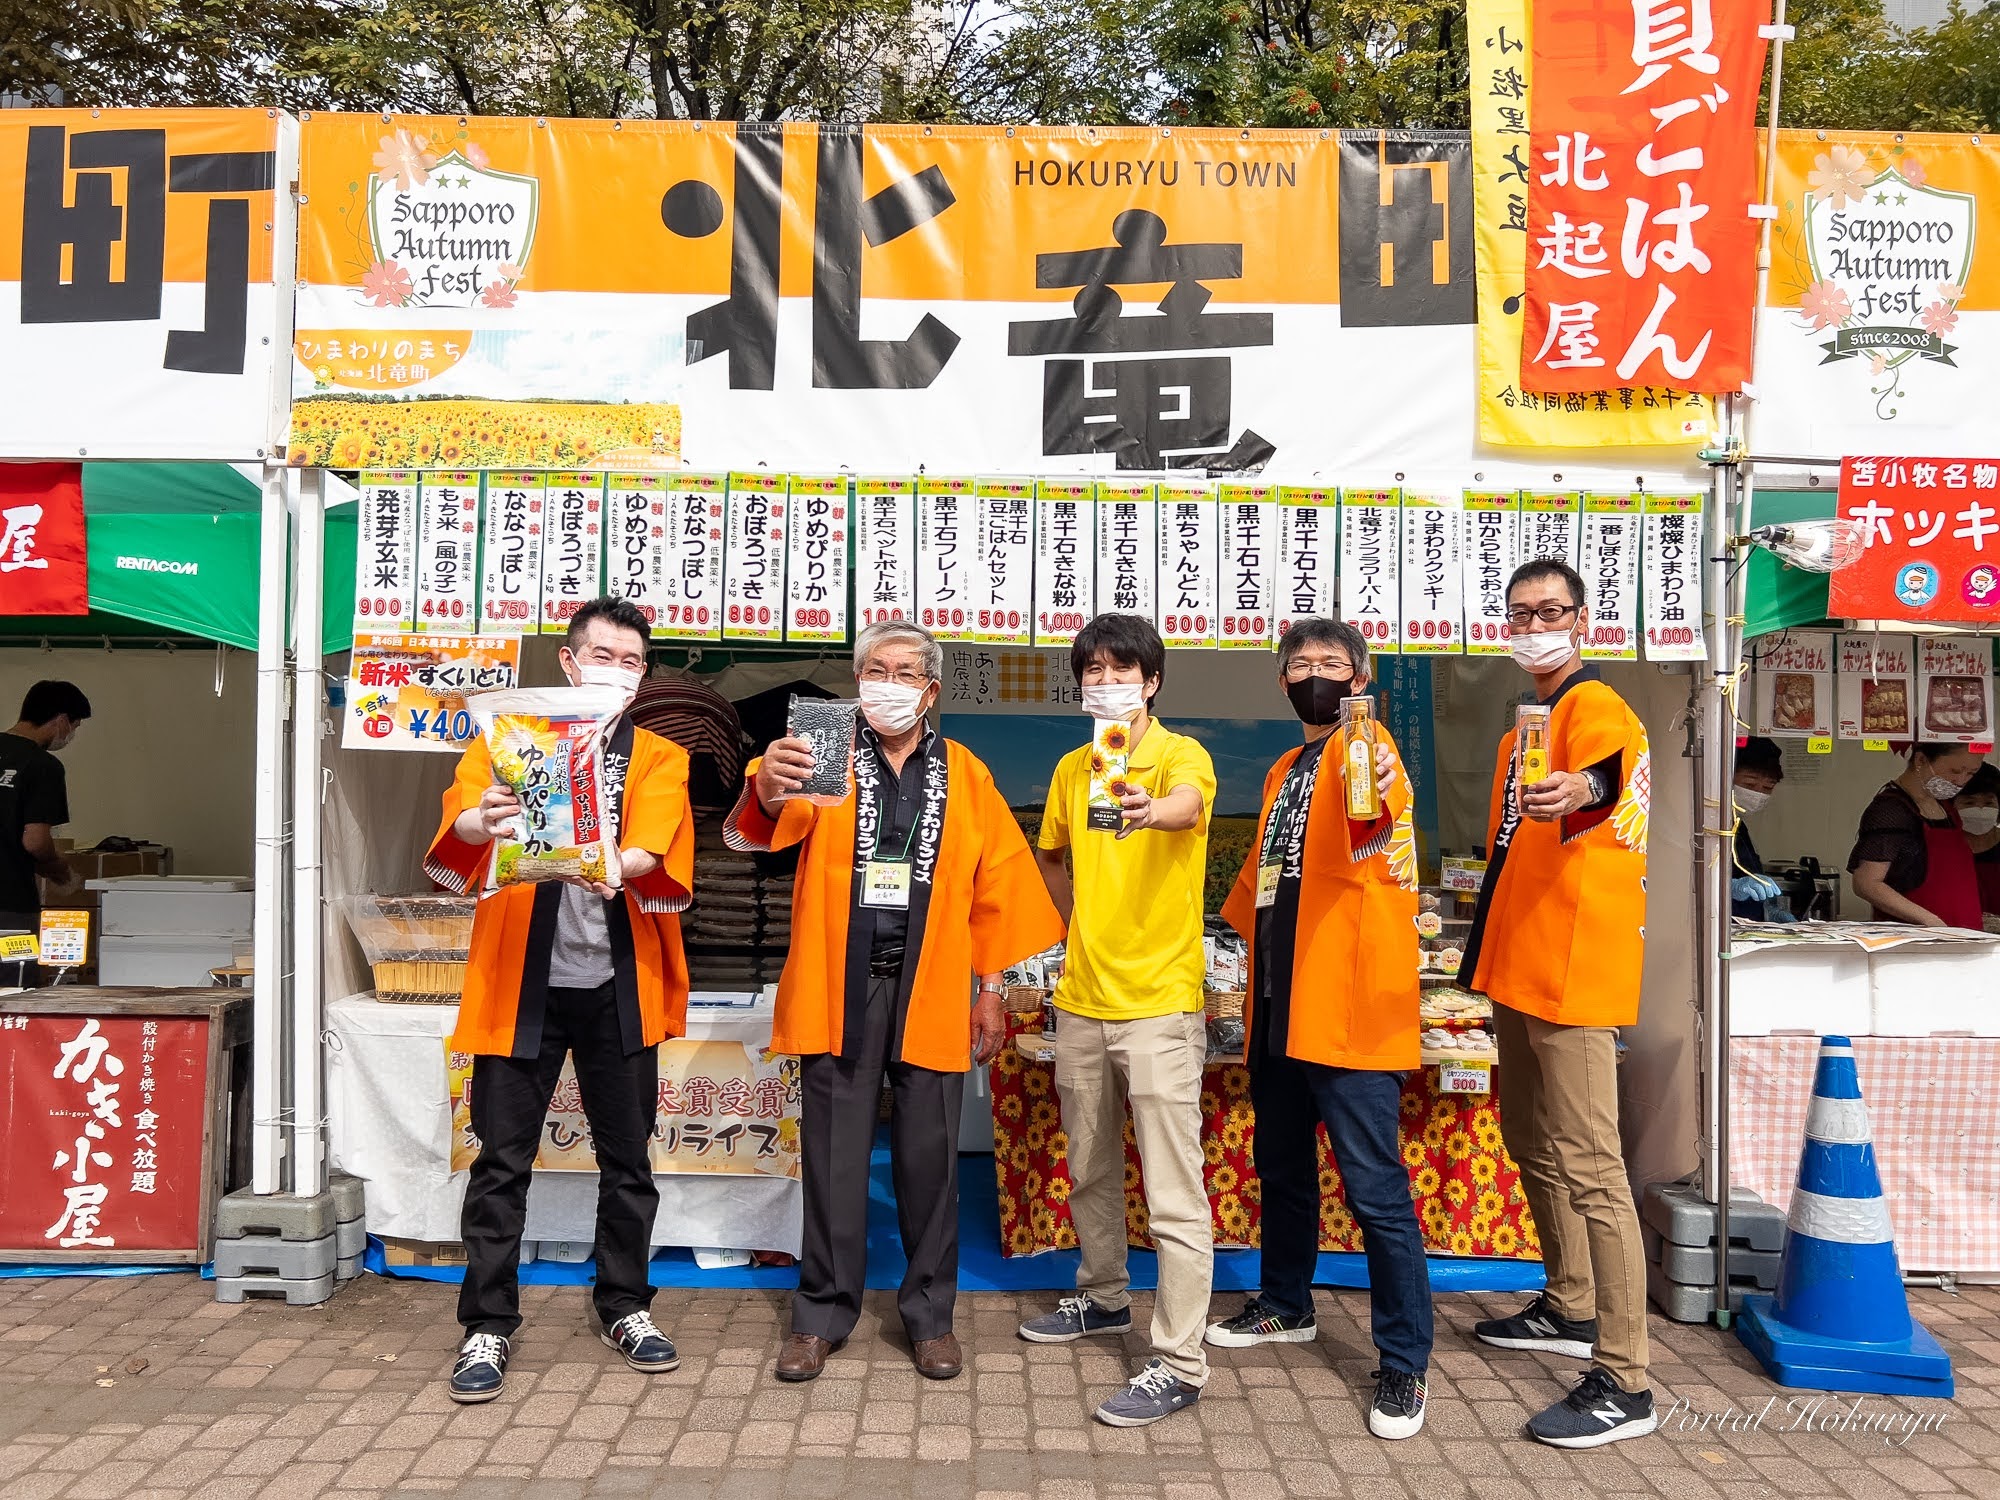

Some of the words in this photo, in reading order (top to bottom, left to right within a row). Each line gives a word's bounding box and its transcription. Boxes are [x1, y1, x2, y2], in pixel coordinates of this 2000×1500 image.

[1015, 160, 1180, 188] HOKURYU
[1195, 161, 1297, 188] TOWN
[391, 194, 515, 228] Sapporo
[391, 230, 513, 261] Autumn
[1826, 212, 1954, 249] Sapporo
[21, 126, 276, 374] 町
[1531, 132, 1612, 370] 北起屋
[1828, 249, 1953, 281] Autumn
[301, 340, 462, 362] ひまわりのまち
[367, 362, 430, 384] 北竜町
[1851, 462, 1998, 489] 苫小牧名物
[0, 503, 49, 572] 屋
[373, 489, 401, 590] 発芽玄米
[1008, 500, 1028, 545] 黒千石
[500, 490, 528, 594] ななつぼし
[559, 490, 586, 595] おぼろづき
[624, 493, 648, 599] ゆめぴりか
[681, 494, 707, 600] ななつぼし
[742, 494, 769, 600] おぼろづき
[805, 497, 830, 602] ゆめぴりか
[934, 496, 958, 602] 黒千石フレーク
[987, 499, 1009, 605] 豆ごはんセット
[1052, 502, 1077, 608] 黒千石きな粉
[1113, 503, 1138, 609] 黒千石きな粉
[1175, 503, 1200, 609] 黒ちゃんどん
[1236, 504, 1261, 610] 黒千石大豆
[1424, 510, 1446, 611] ひまわりクッキー
[116, 556, 198, 575] RENTACOM
[1291, 508, 1319, 614] 黒千石大豆
[1358, 507, 1382, 615] 北竜サンフラワーバーム
[1478, 511, 1504, 617] 田からもちおかき
[1594, 517, 1624, 621] 一番しぼりひまわり油
[1659, 514, 1685, 622] 燦燦ひまわり油
[359, 597, 402, 616] 900
[421, 598, 464, 618] 440
[484, 600, 530, 620] 1,750
[667, 605, 710, 624] 780
[728, 604, 771, 624] 880
[794, 608, 831, 627] 980
[922, 608, 964, 627] 350
[978, 610, 1021, 629] 500
[1038, 612, 1084, 633] 1,000
[1164, 614, 1208, 634] 500
[1223, 615, 1265, 634] 500
[371, 635, 403, 647] 第46回
[408, 637, 461, 650] 日本農業賞
[464, 639, 507, 650] 大賞受賞
[1407, 620, 1452, 639] 900
[1582, 626, 1626, 646] 1,000
[1647, 626, 1694, 646] 1,000
[359, 661, 412, 688] 新米
[975, 652, 994, 704] あかるい
[367, 719, 392, 734] 1回
[517, 743, 554, 858] ゆめぴりか
[913, 756, 948, 885] 北竜ひまわりライス
[1452, 1078, 1477, 1091] 500
[49, 1109, 90, 1119] kaki-goya
[45, 1018, 125, 1248] かき小屋
[130, 1107, 160, 1195] 食べ放題
[1592, 1400, 1627, 1428] N
